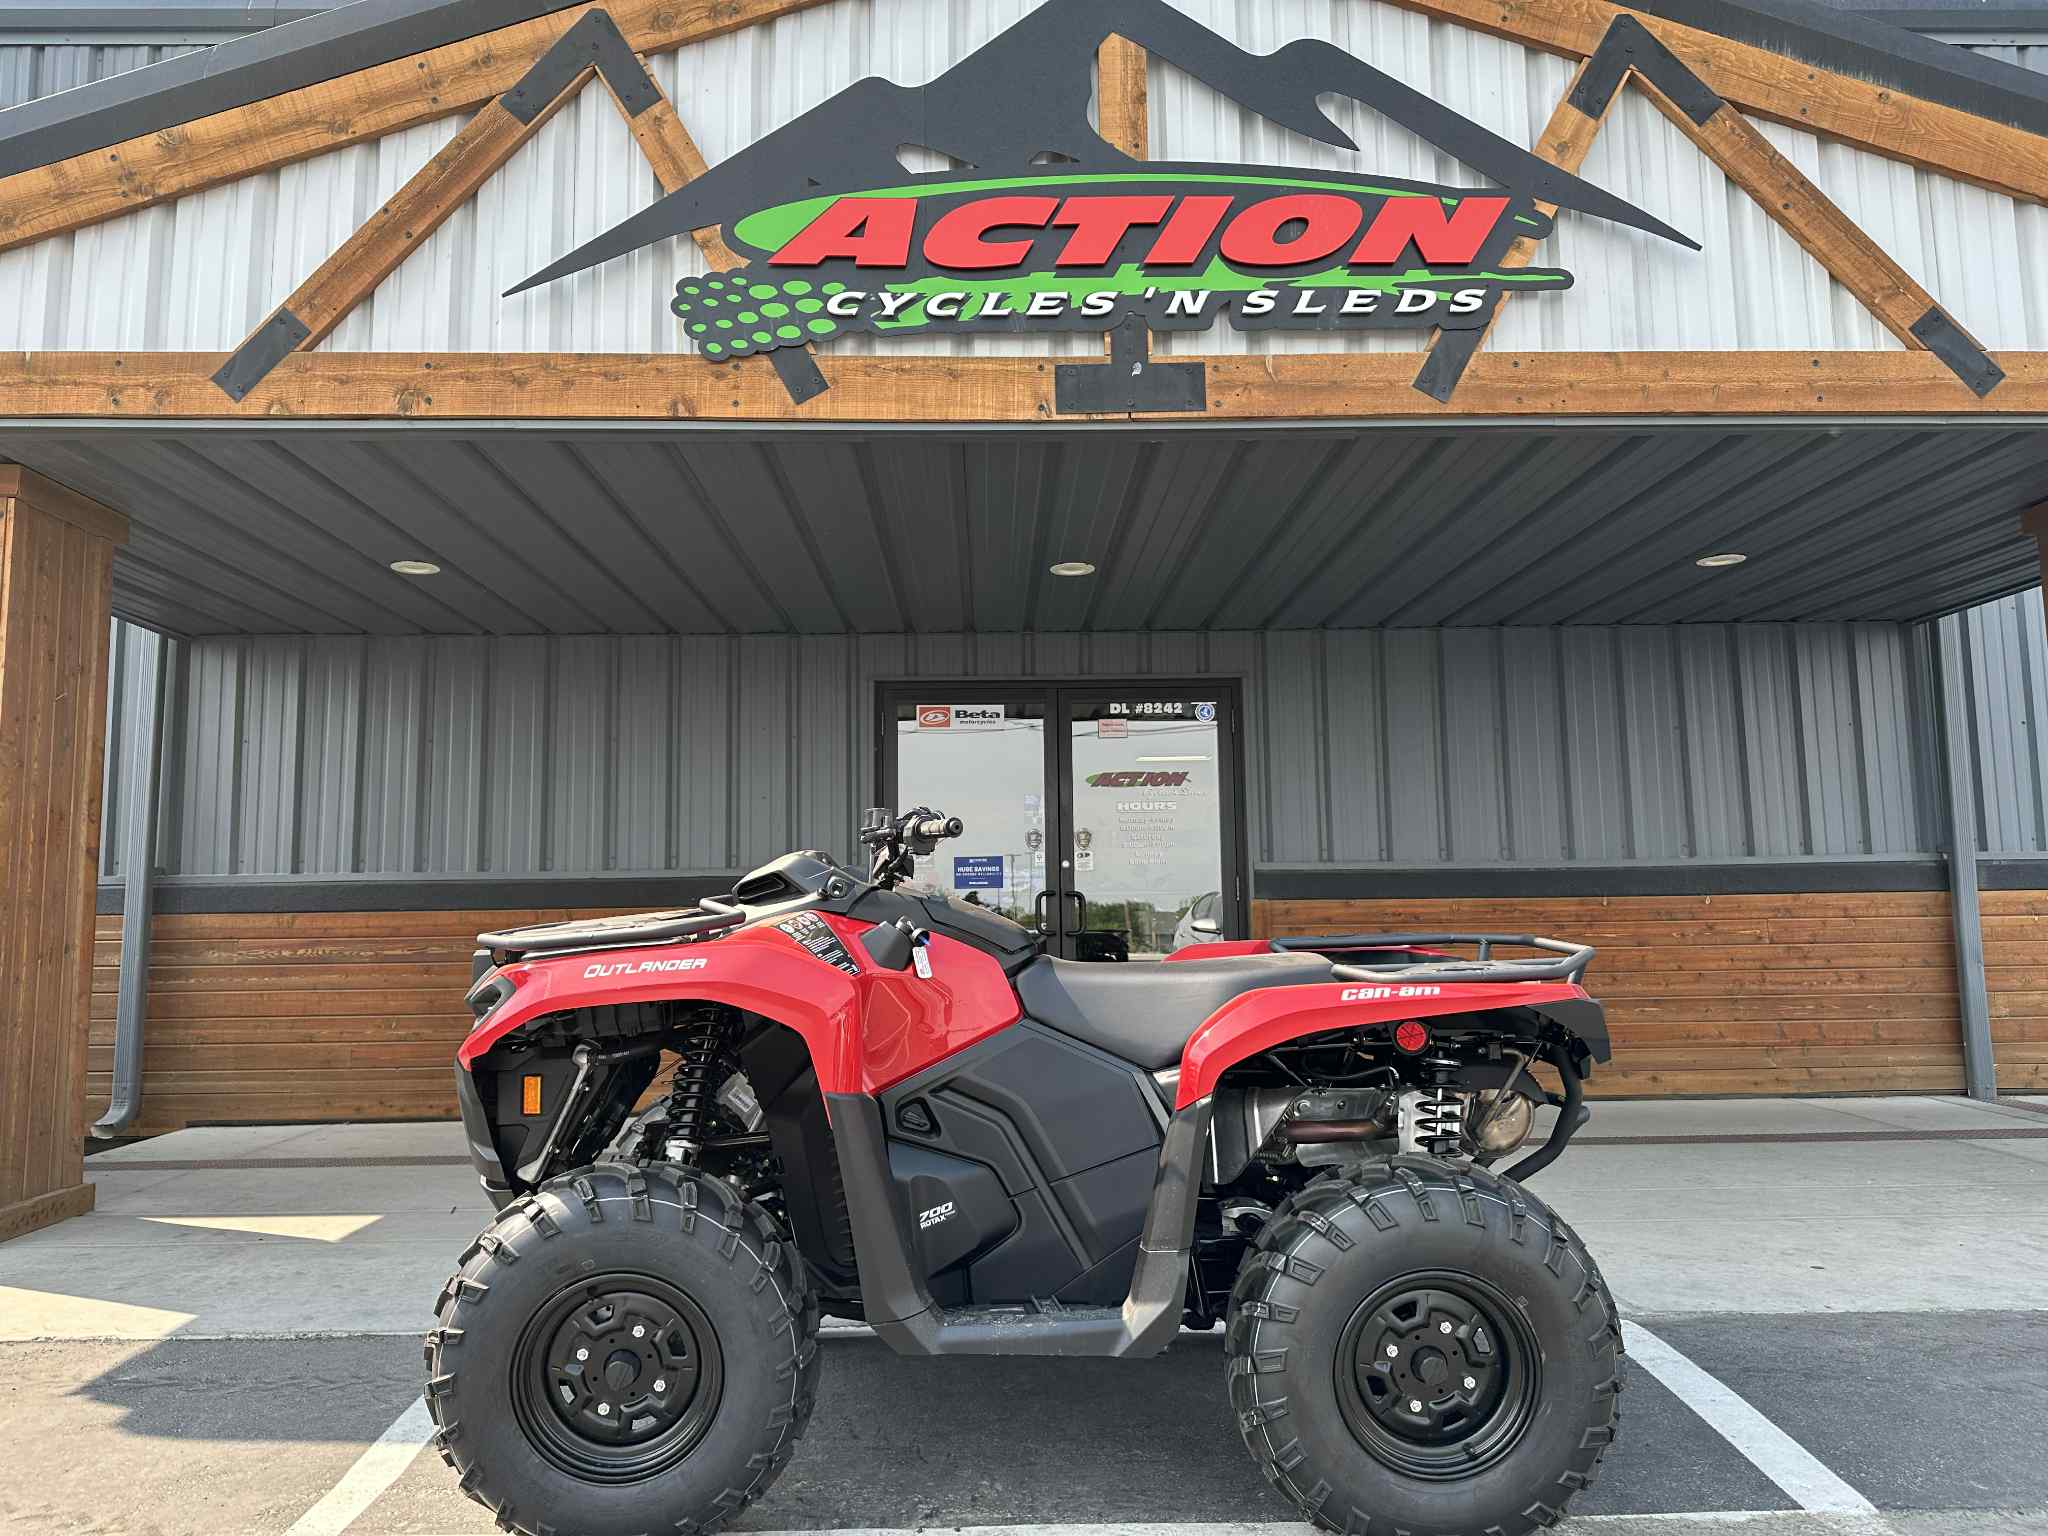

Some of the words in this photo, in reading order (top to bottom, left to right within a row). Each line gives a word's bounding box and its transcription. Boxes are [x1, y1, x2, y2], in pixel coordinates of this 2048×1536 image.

[767, 193, 1512, 269] ACTION
[825, 289, 1120, 318] CYCLES
[1143, 286, 1210, 316] 'N
[1241, 288, 1487, 316] SLEDS
[954, 709, 1001, 719] Beta
[1109, 702, 1130, 714] DL
[1135, 702, 1183, 714] #8242
[1092, 771, 1189, 787] ACTION
[1117, 801, 1177, 810] HOURS
[583, 958, 708, 979] OUTLANDER
[1341, 986, 1440, 1001] can-am
[919, 1201, 953, 1222] 700
[919, 1214, 947, 1230] ROTAX
